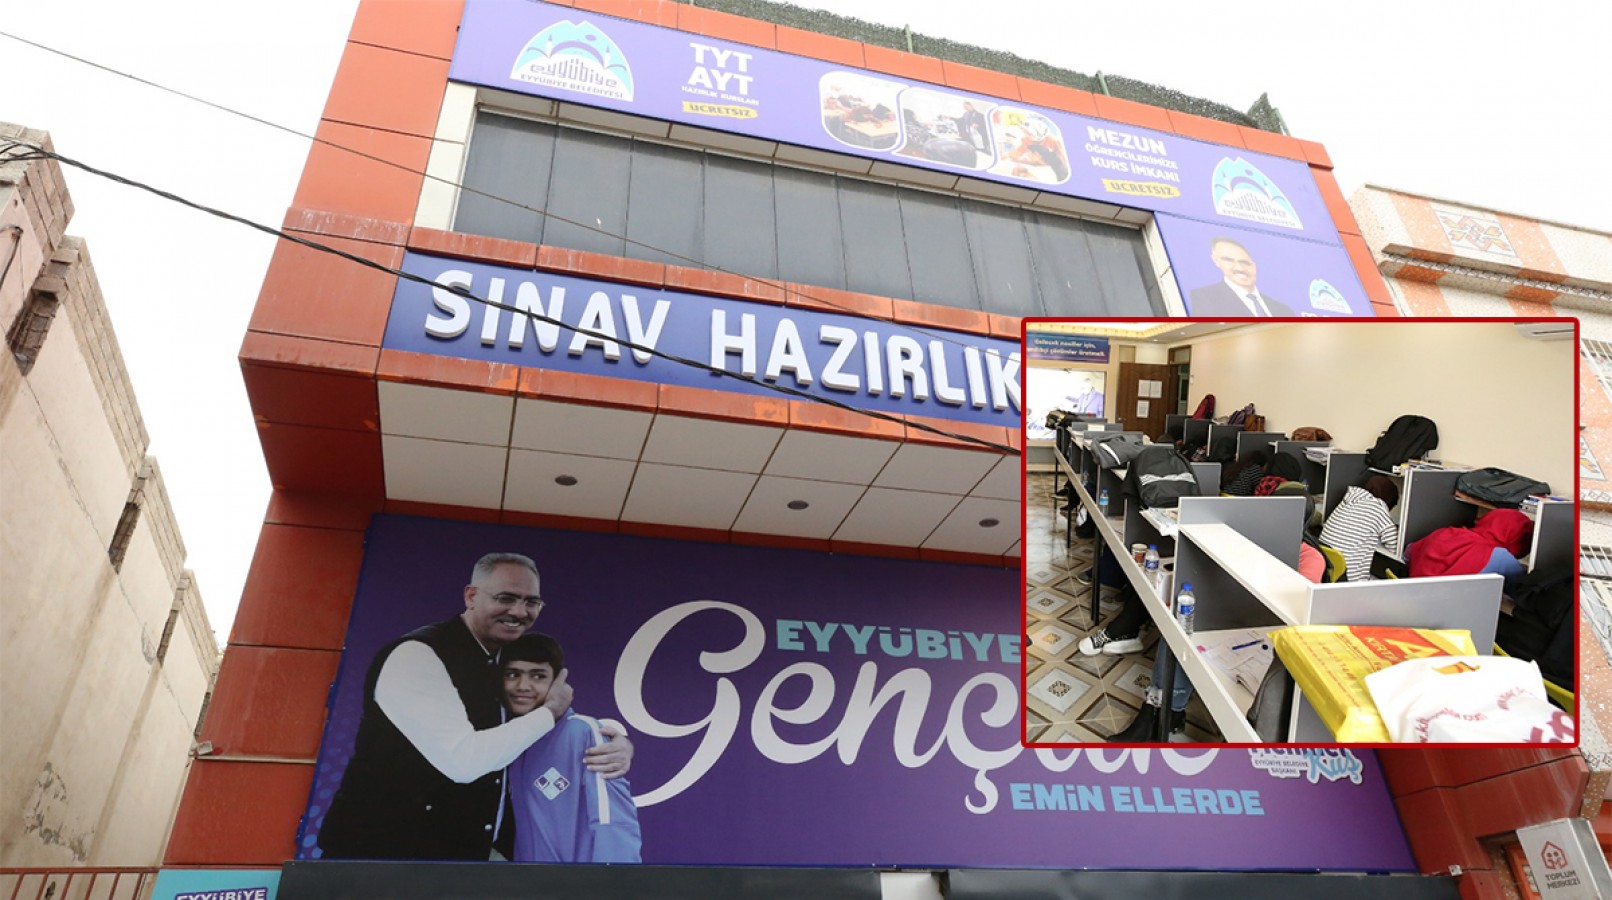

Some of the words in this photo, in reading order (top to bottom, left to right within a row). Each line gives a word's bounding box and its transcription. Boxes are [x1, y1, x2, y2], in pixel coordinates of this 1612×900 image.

[689, 42, 753, 73] TYT
[530, 58, 618, 88] eyyübiye
[687, 65, 754, 96] AYT
[1087, 126, 1168, 156] MEZUN
[1090, 156, 1129, 173] KURS
[424, 268, 670, 365] SINAV
[708, 307, 1022, 413] HAZIRLIK
[1110, 786, 1265, 816] ELLERDE
[1545, 869, 1577, 881] TOPLUM
